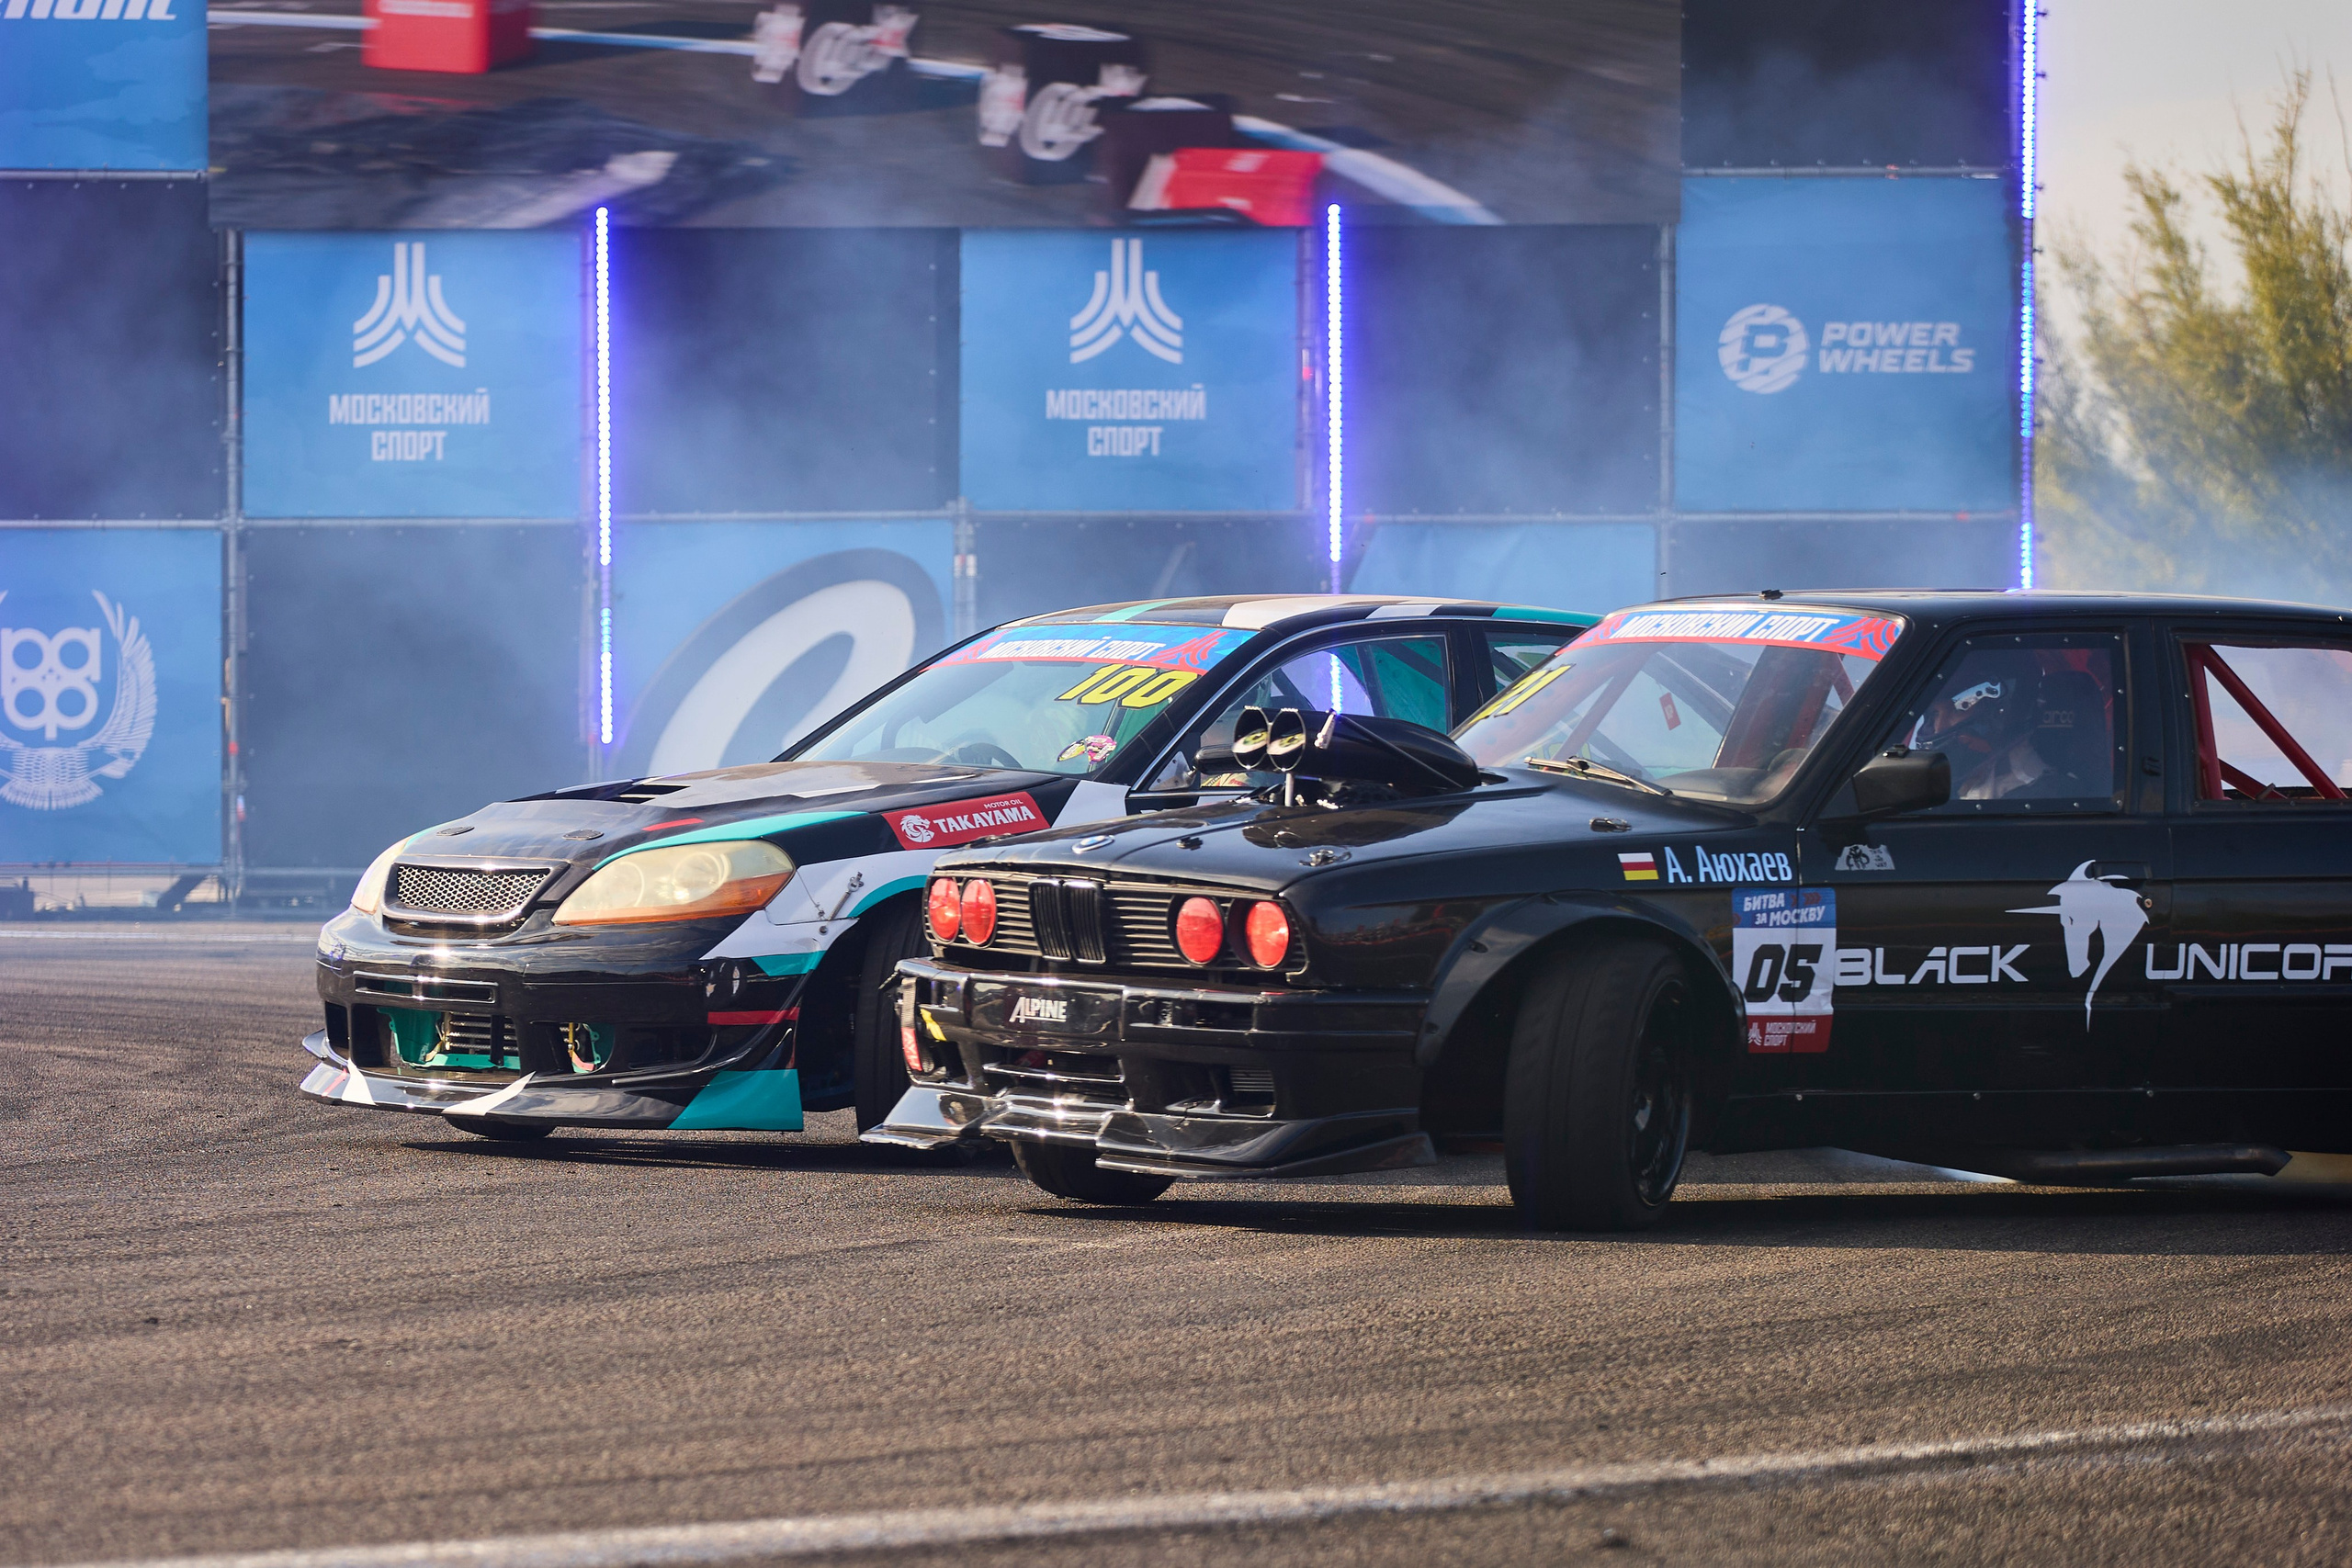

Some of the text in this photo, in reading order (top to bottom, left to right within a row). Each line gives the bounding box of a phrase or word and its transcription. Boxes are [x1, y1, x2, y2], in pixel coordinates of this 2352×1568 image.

[1821, 321, 1962, 347] POWER
[1818, 348, 1976, 373] WHEELS
[328, 387, 491, 425] МОСКОВСКИЙ
[1045, 382, 1205, 420] МОСКОВСКИЙ
[370, 430, 447, 460] СПОРТ
[1087, 425, 1163, 457] СПОРТ
[1609, 611, 1841, 643] МОСКОВСКИЙ СПОРТ
[976, 636, 1167, 661] МОСКОВСКИЙ СПОРТ
[1054, 663, 1200, 709] 100
[933, 806, 1036, 834] TAKAYAMA
[983, 800, 1011, 809] MOTOR
[1664, 845, 1792, 883] А. Аюхаев
[1743, 892, 1785, 912] БИТВА
[1754, 905, 1826, 927] ЗА МОСКВУ
[1743, 943, 1824, 1002] 05
[1834, 944, 2030, 987] BLACK
